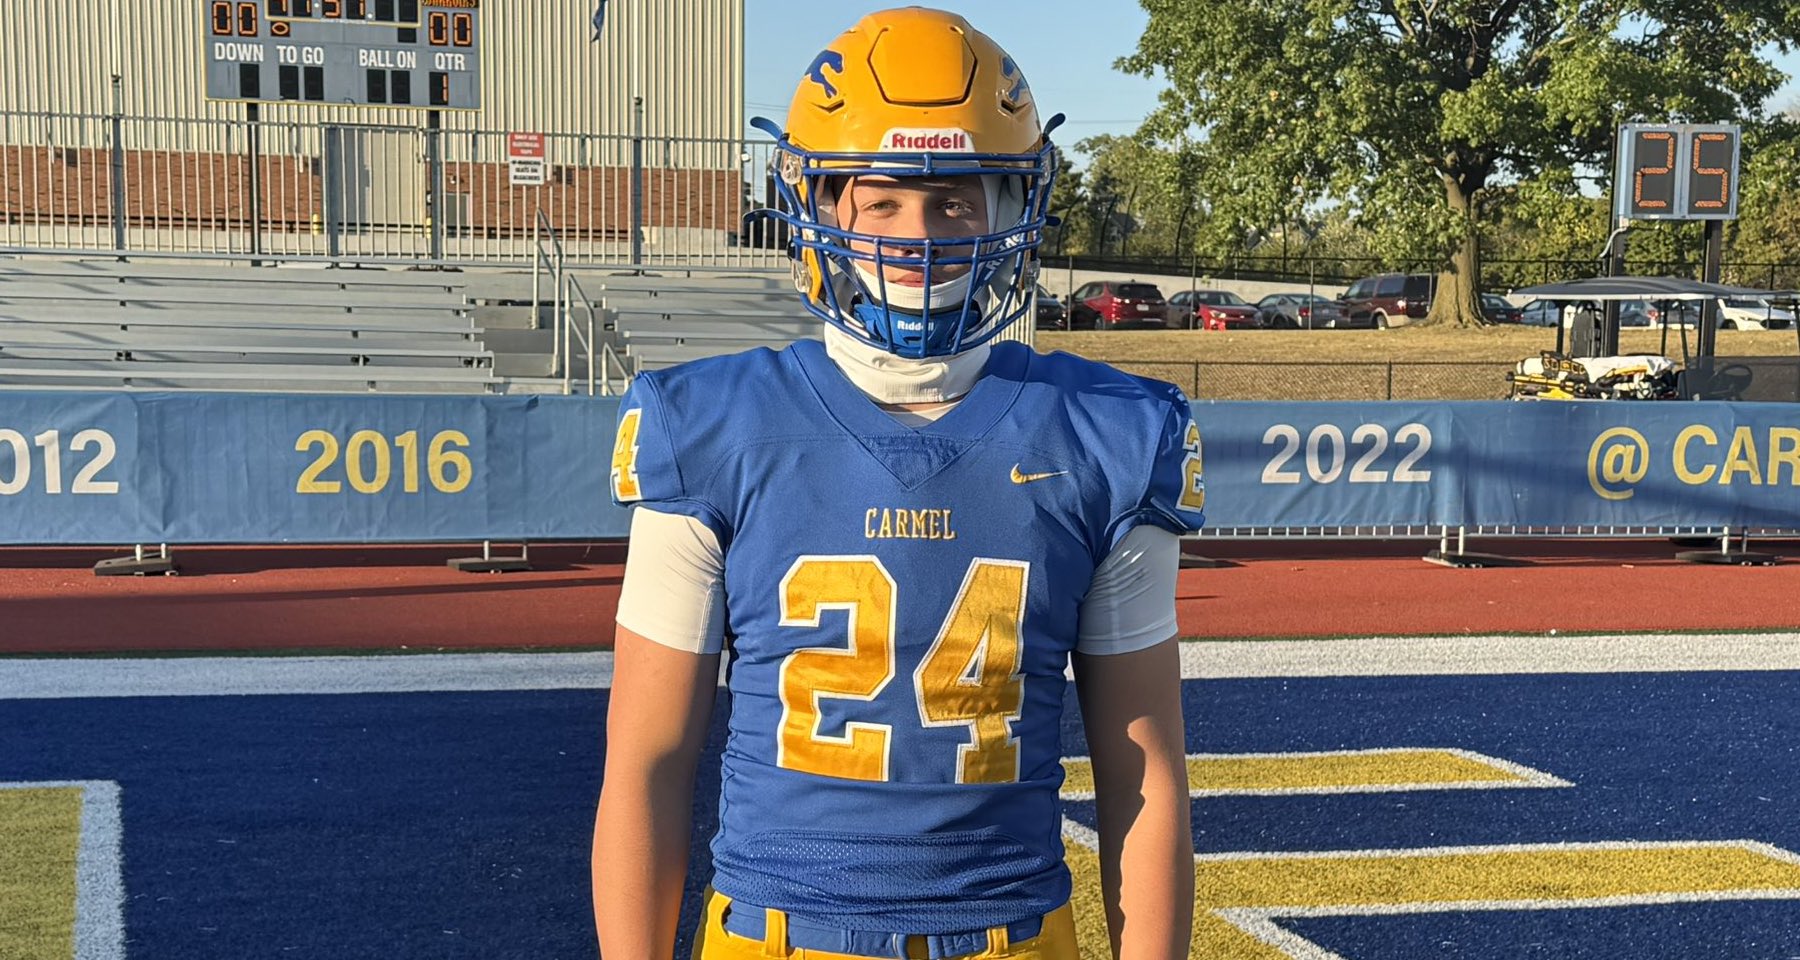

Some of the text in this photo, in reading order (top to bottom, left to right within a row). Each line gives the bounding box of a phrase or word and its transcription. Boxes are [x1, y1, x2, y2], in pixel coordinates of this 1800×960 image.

[213, 2, 257, 35] 00
[430, 12, 471, 45] 00
[214, 42, 265, 62] DOWN
[276, 45, 325, 65] TO GO
[359, 49, 416, 69] BALL ON
[434, 53, 466, 71] QTR
[892, 133, 966, 149] Riddell
[1635, 132, 1728, 208] 25
[897, 320, 935, 331] Riddll
[294, 429, 473, 494] 2016
[611, 408, 643, 502] 4
[1261, 423, 1432, 485] 2022
[1587, 424, 1800, 500] @ CAR
[865, 507, 956, 539] CARMEL
[777, 554, 1030, 784] 24
